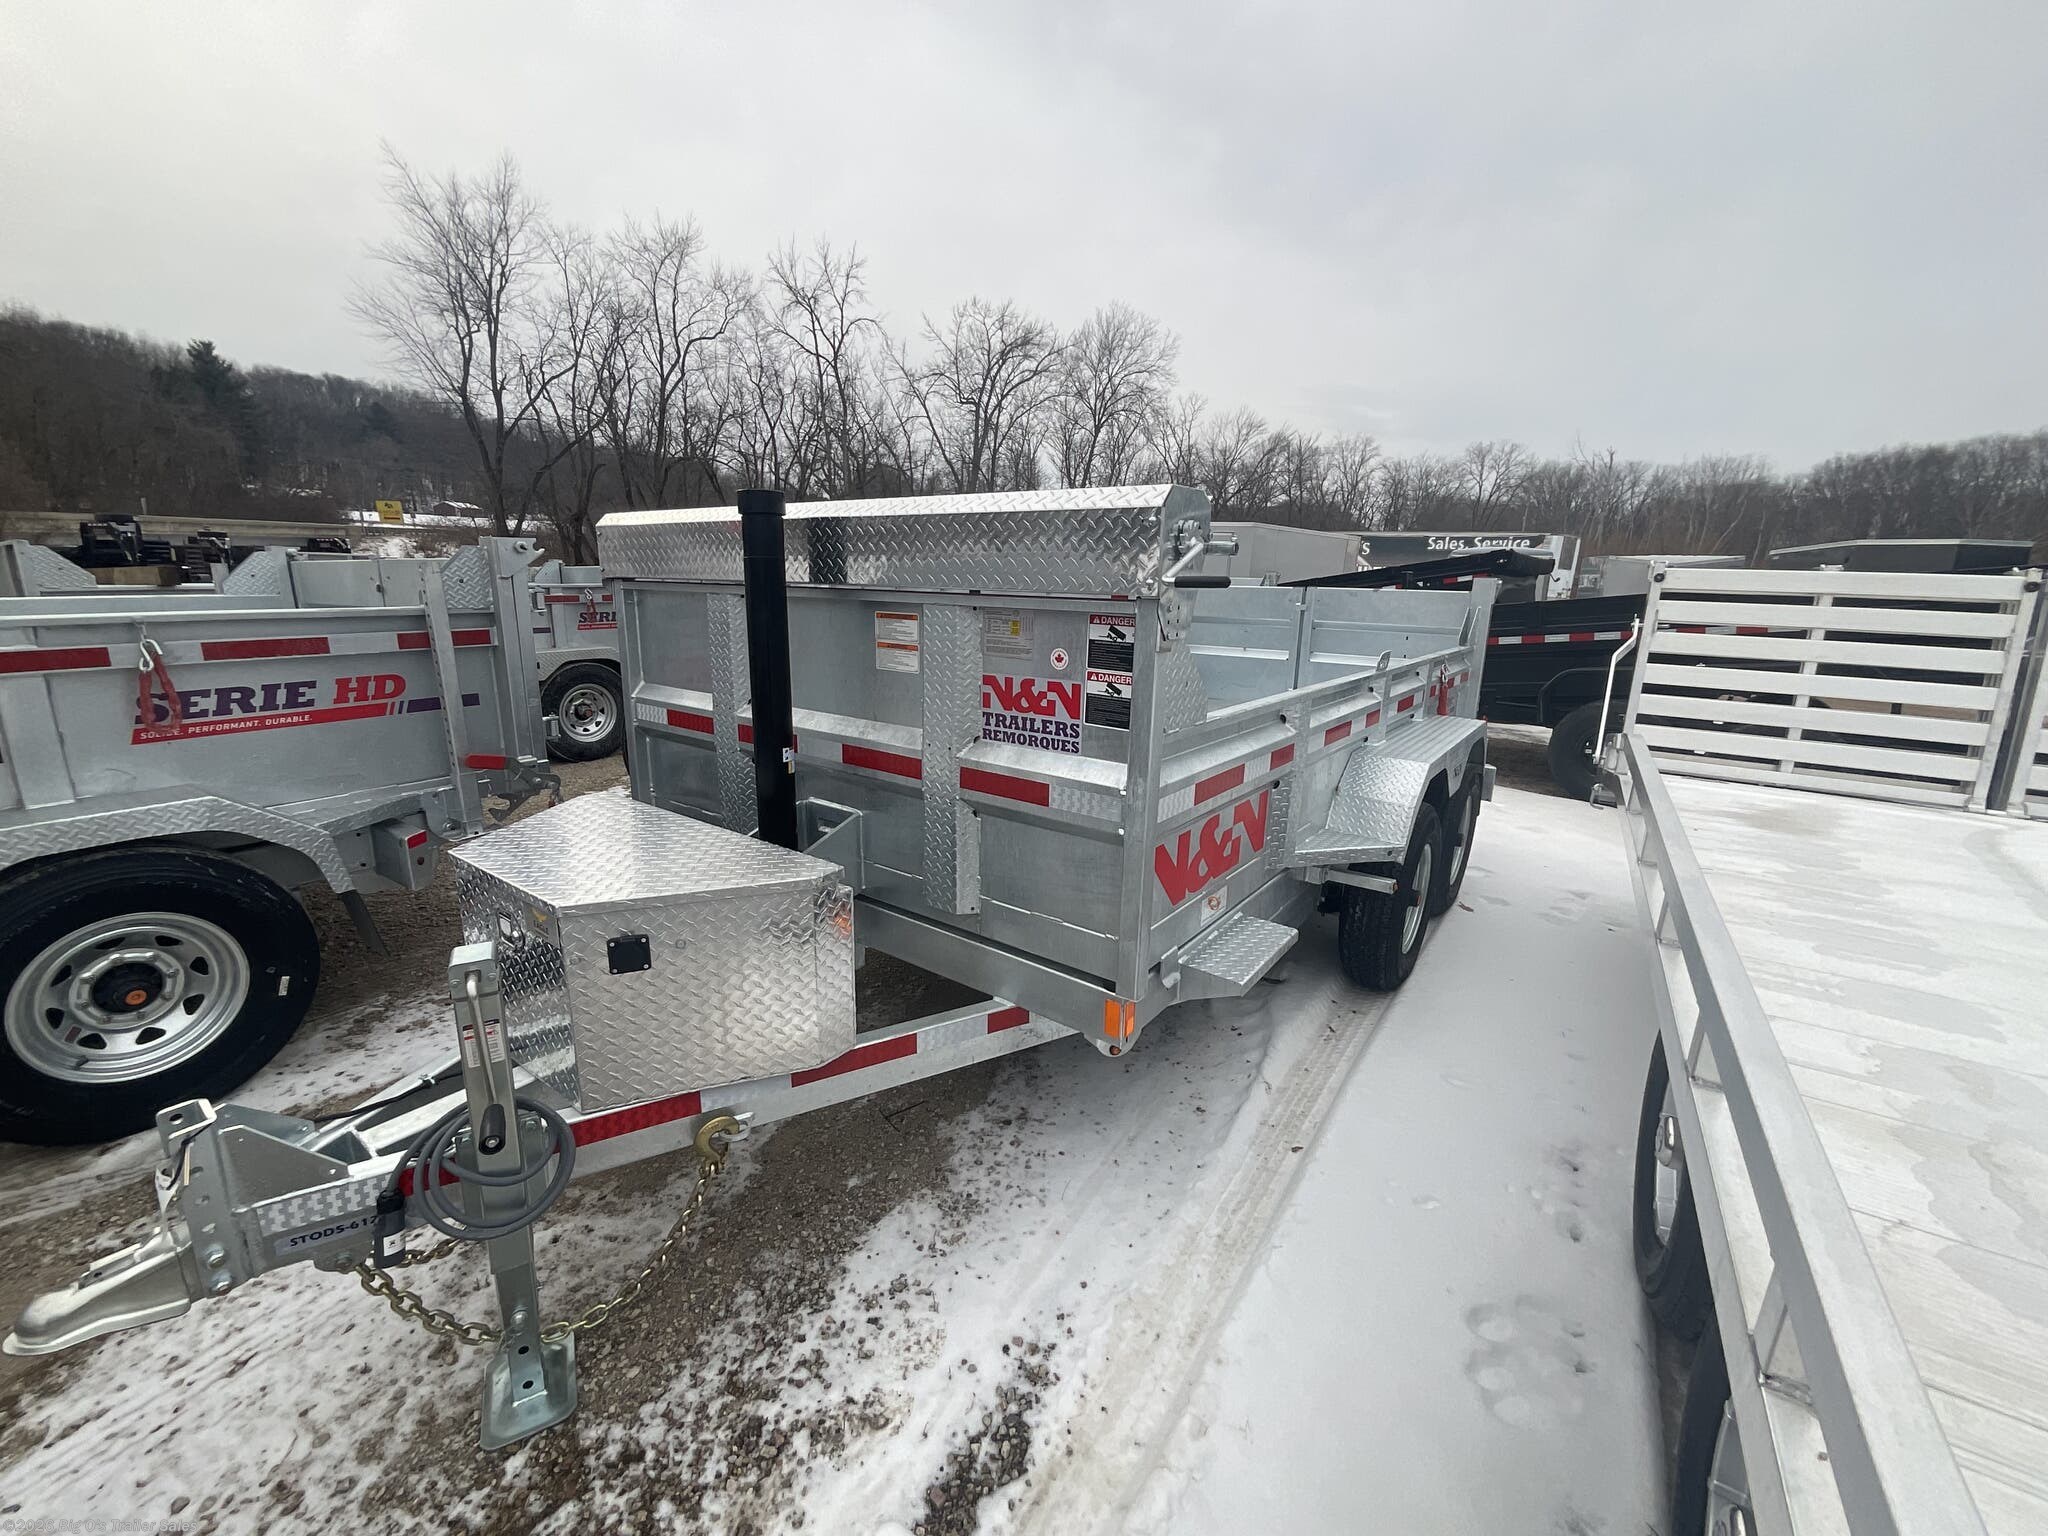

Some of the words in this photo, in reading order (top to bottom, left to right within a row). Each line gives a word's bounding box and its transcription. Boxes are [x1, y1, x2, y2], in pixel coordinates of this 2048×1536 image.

[1473, 536, 1531, 550] Service
[1100, 616, 1136, 627] DANGER
[1098, 673, 1132, 685] DANGER
[134, 680, 317, 724] SERIE
[333, 673, 407, 705] HD
[982, 674, 1081, 720] N&N
[187, 719, 262, 734] PERFORMANT.
[265, 714, 313, 726] DURABLE.
[982, 711, 1080, 739] TRAILERS
[982, 727, 1080, 754] REMORQUES
[1154, 789, 1270, 907] N&N
